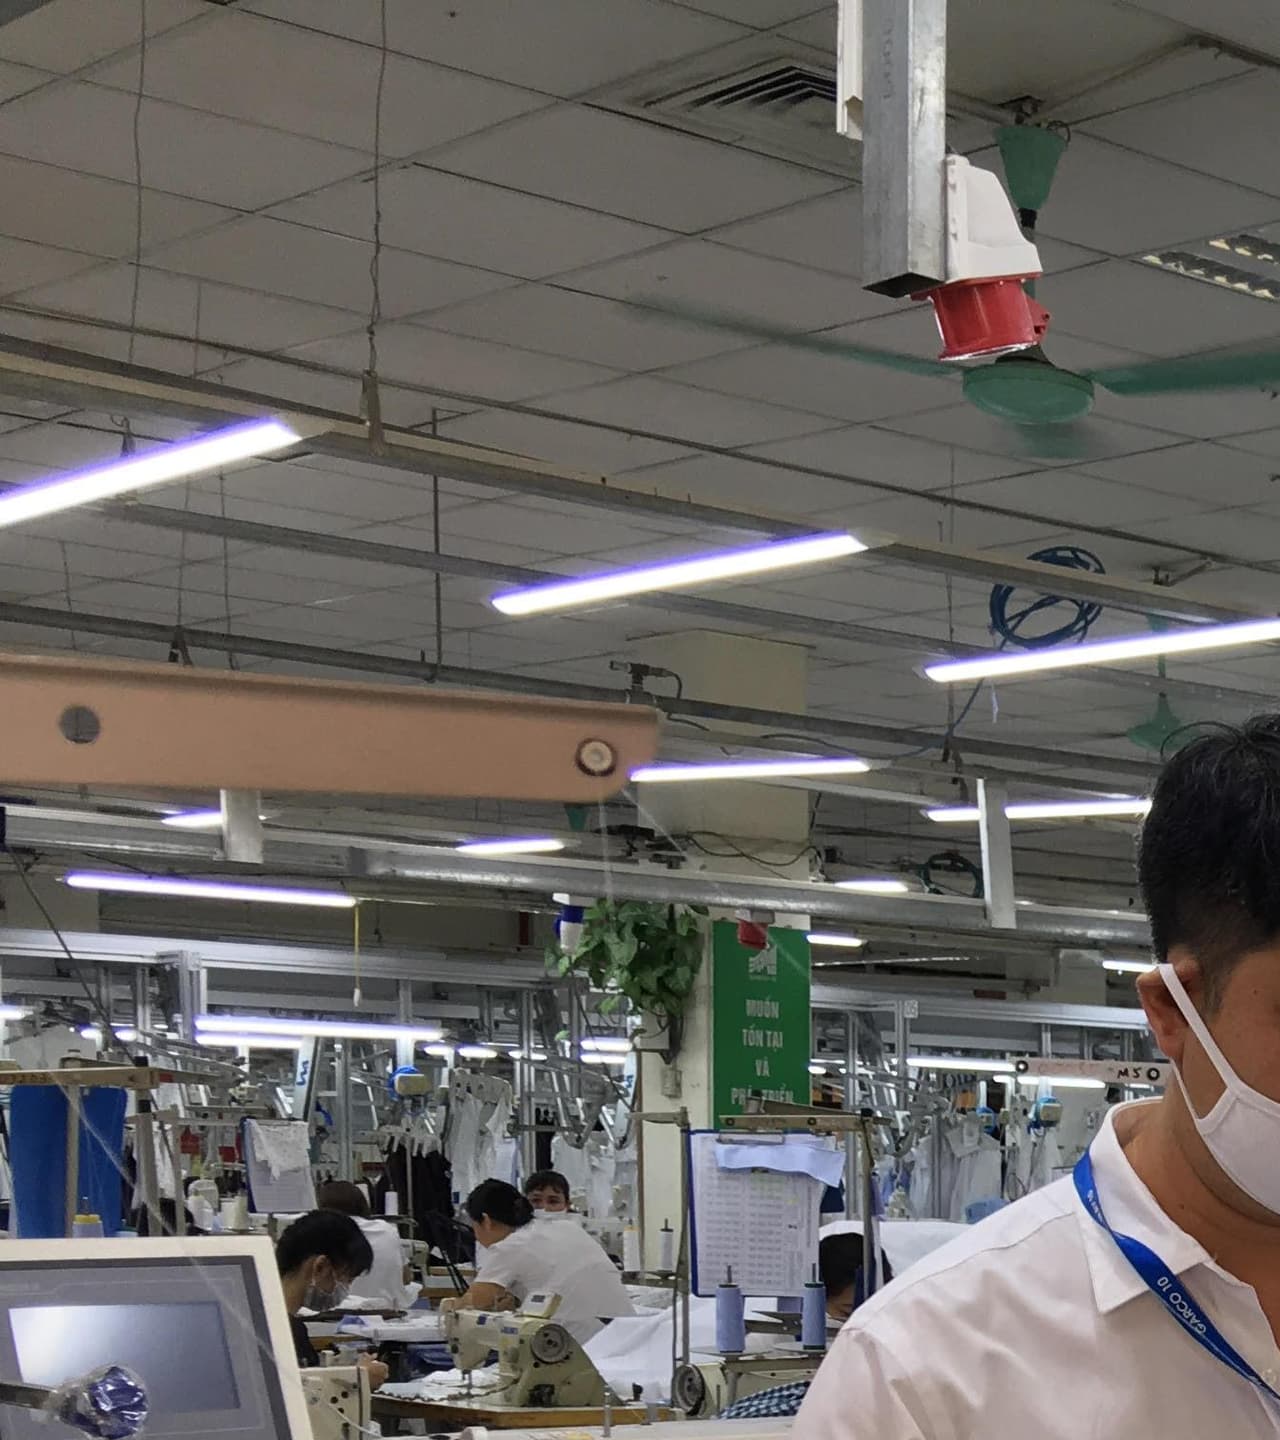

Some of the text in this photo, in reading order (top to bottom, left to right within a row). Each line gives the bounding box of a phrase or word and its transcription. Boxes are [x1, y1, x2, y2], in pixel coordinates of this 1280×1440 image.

[731, 1085, 759, 1105] PHÁ
[1157, 1276, 1207, 1334] GARCO 10
